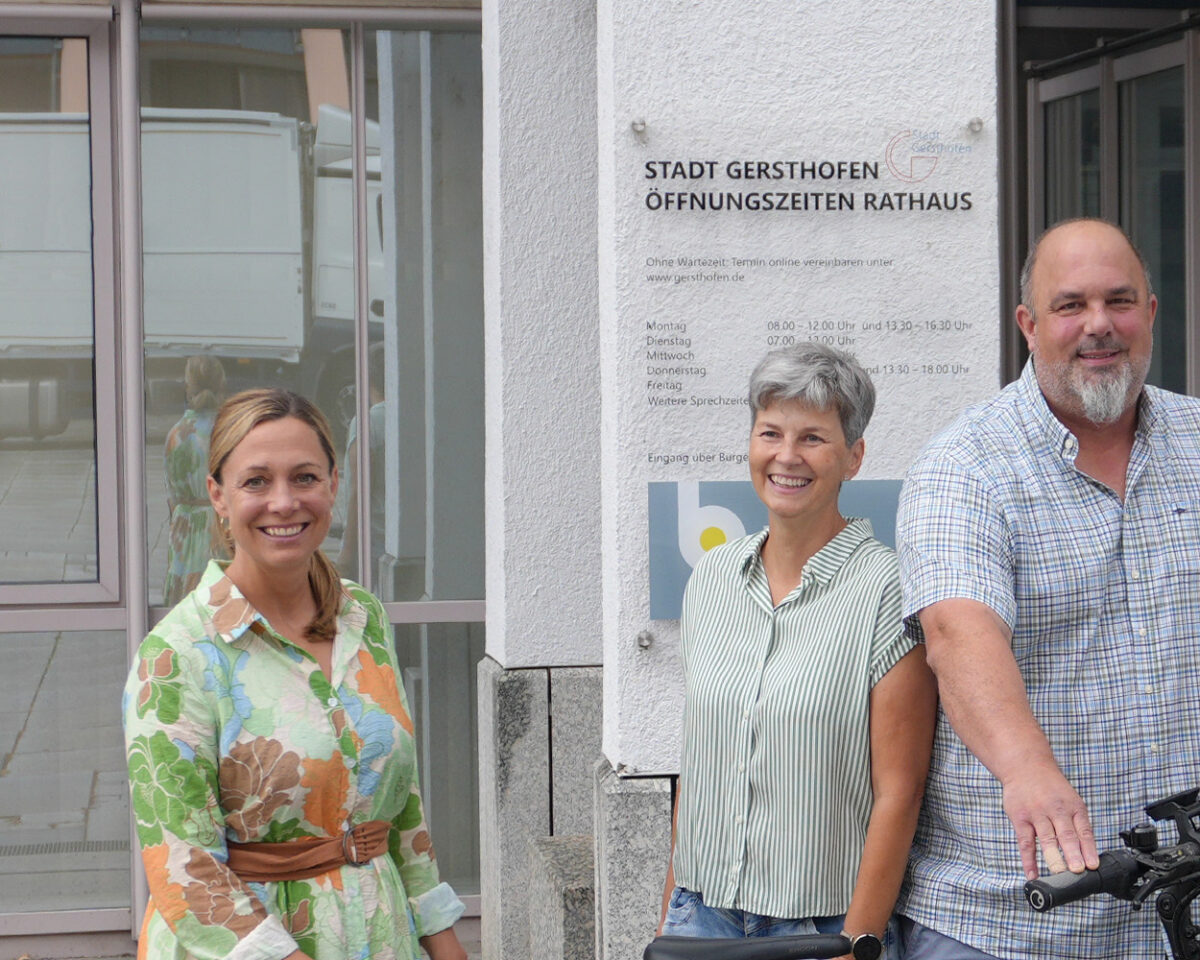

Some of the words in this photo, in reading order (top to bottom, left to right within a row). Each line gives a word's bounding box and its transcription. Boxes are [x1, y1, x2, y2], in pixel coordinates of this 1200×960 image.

[645, 161, 718, 179] STADT
[726, 161, 879, 179] GERSTHOFEN
[645, 187, 854, 211] ÖFFNUNGSZEITEN
[864, 192, 973, 211] RATHAUS
[646, 257, 674, 267] Ohne
[731, 257, 766, 267] Termin
[768, 257, 800, 267] online
[803, 257, 863, 267] vereinbaren
[866, 258, 893, 267] unter
[646, 272, 745, 284] www.gersthofen.de
[646, 321, 687, 333] Montag
[837, 321, 855, 331] Uhr
[862, 320, 881, 331] und
[954, 320, 973, 331] Uhr
[646, 336, 692, 348] Dienstag
[837, 335, 856, 346] Uhr
[646, 351, 695, 361] Mittwoch
[646, 366, 707, 378] Donnerstag
[951, 365, 969, 375] Uhr
[647, 381, 682, 392] Freitag
[648, 396, 687, 406] Weitere
[690, 395, 749, 407] Sprechzeite
[647, 452, 689, 465] Eingang
